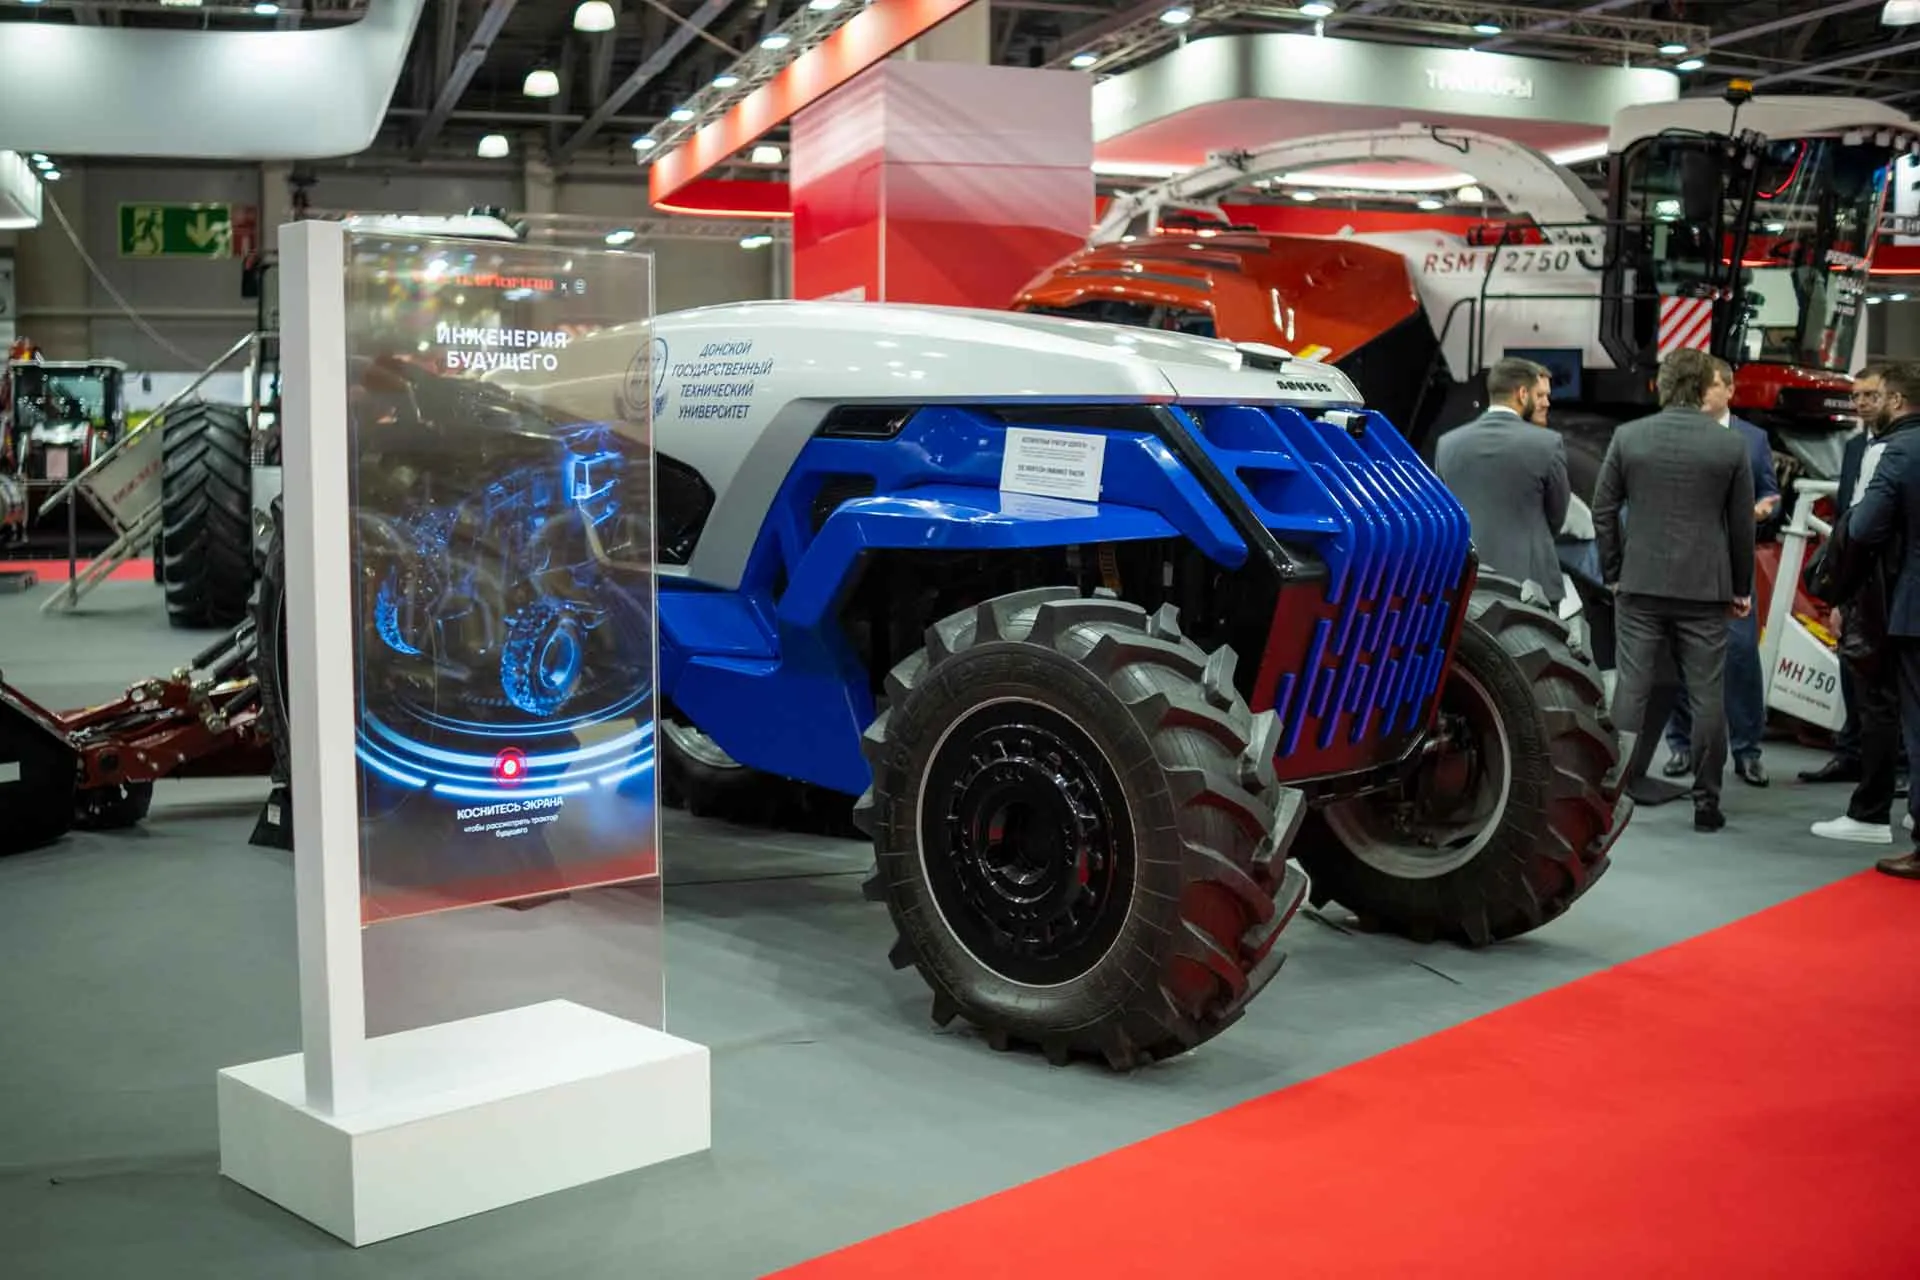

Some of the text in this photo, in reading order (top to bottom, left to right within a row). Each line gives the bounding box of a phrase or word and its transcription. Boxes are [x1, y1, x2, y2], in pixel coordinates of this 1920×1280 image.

[1423, 251, 1475, 272] RSM
[1503, 250, 1571, 272] 2750
[436, 325, 568, 348] ИНЖЕНЕРИЯ
[699, 341, 752, 357] ДОНСКОЙ
[447, 351, 558, 372] БУДУЩЕГО
[672, 358, 774, 378] ГОСУДАРСТВЕННЫЙ
[680, 380, 754, 398] ТЕХНИЧЕСКИЙ
[678, 404, 751, 419] УНИВЕРСИТЕТ
[456, 796, 564, 820] КОСНИТЕСЬ ЭКРАНА
